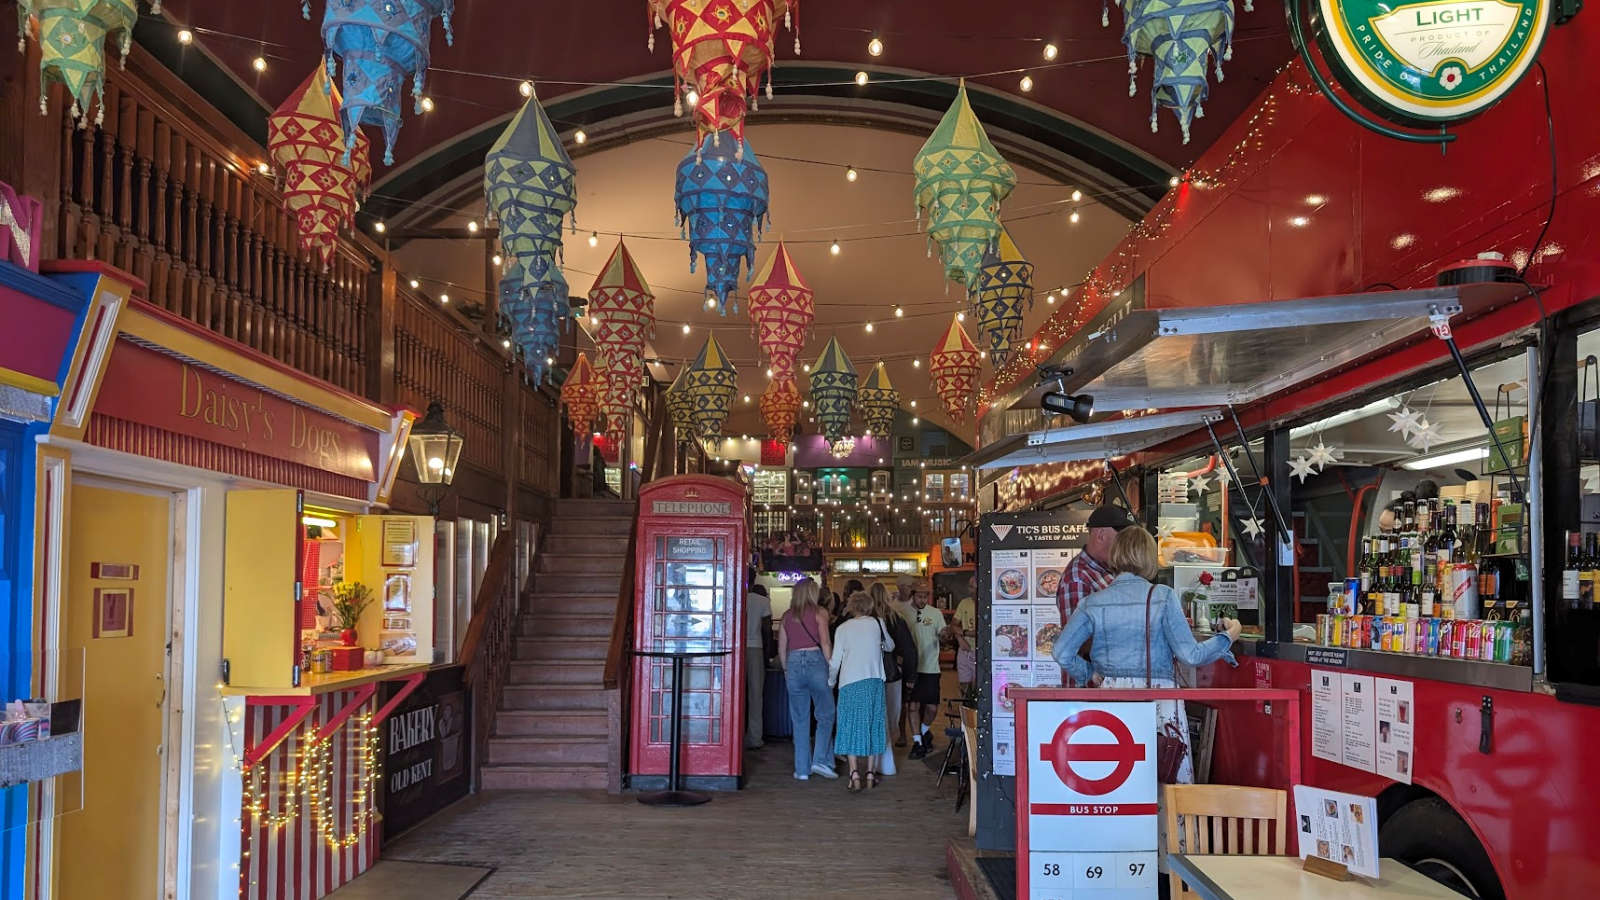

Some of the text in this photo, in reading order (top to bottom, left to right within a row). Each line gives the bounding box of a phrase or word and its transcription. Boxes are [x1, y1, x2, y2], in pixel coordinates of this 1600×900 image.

[1415, 7, 1485, 27] LIGHT
[1410, 30, 1469, 42] PRODUCT
[1356, 8, 1532, 85] PRIDE OF THAILAND
[1417, 40, 1481, 58] Thailand
[179, 364, 341, 468] Daisy's Dogs
[657, 502, 728, 514] TELEPHONE
[1016, 525, 1040, 534] TIC'S
[1041, 525, 1060, 534] BUS
[672, 546, 706, 554] SHOPPING
[389, 704, 439, 755] BAKERY
[391, 758, 433, 793] OLD KENT
[1069, 805, 1119, 814] BUS STOP
[1043, 863, 1146, 879] 58 69 97
